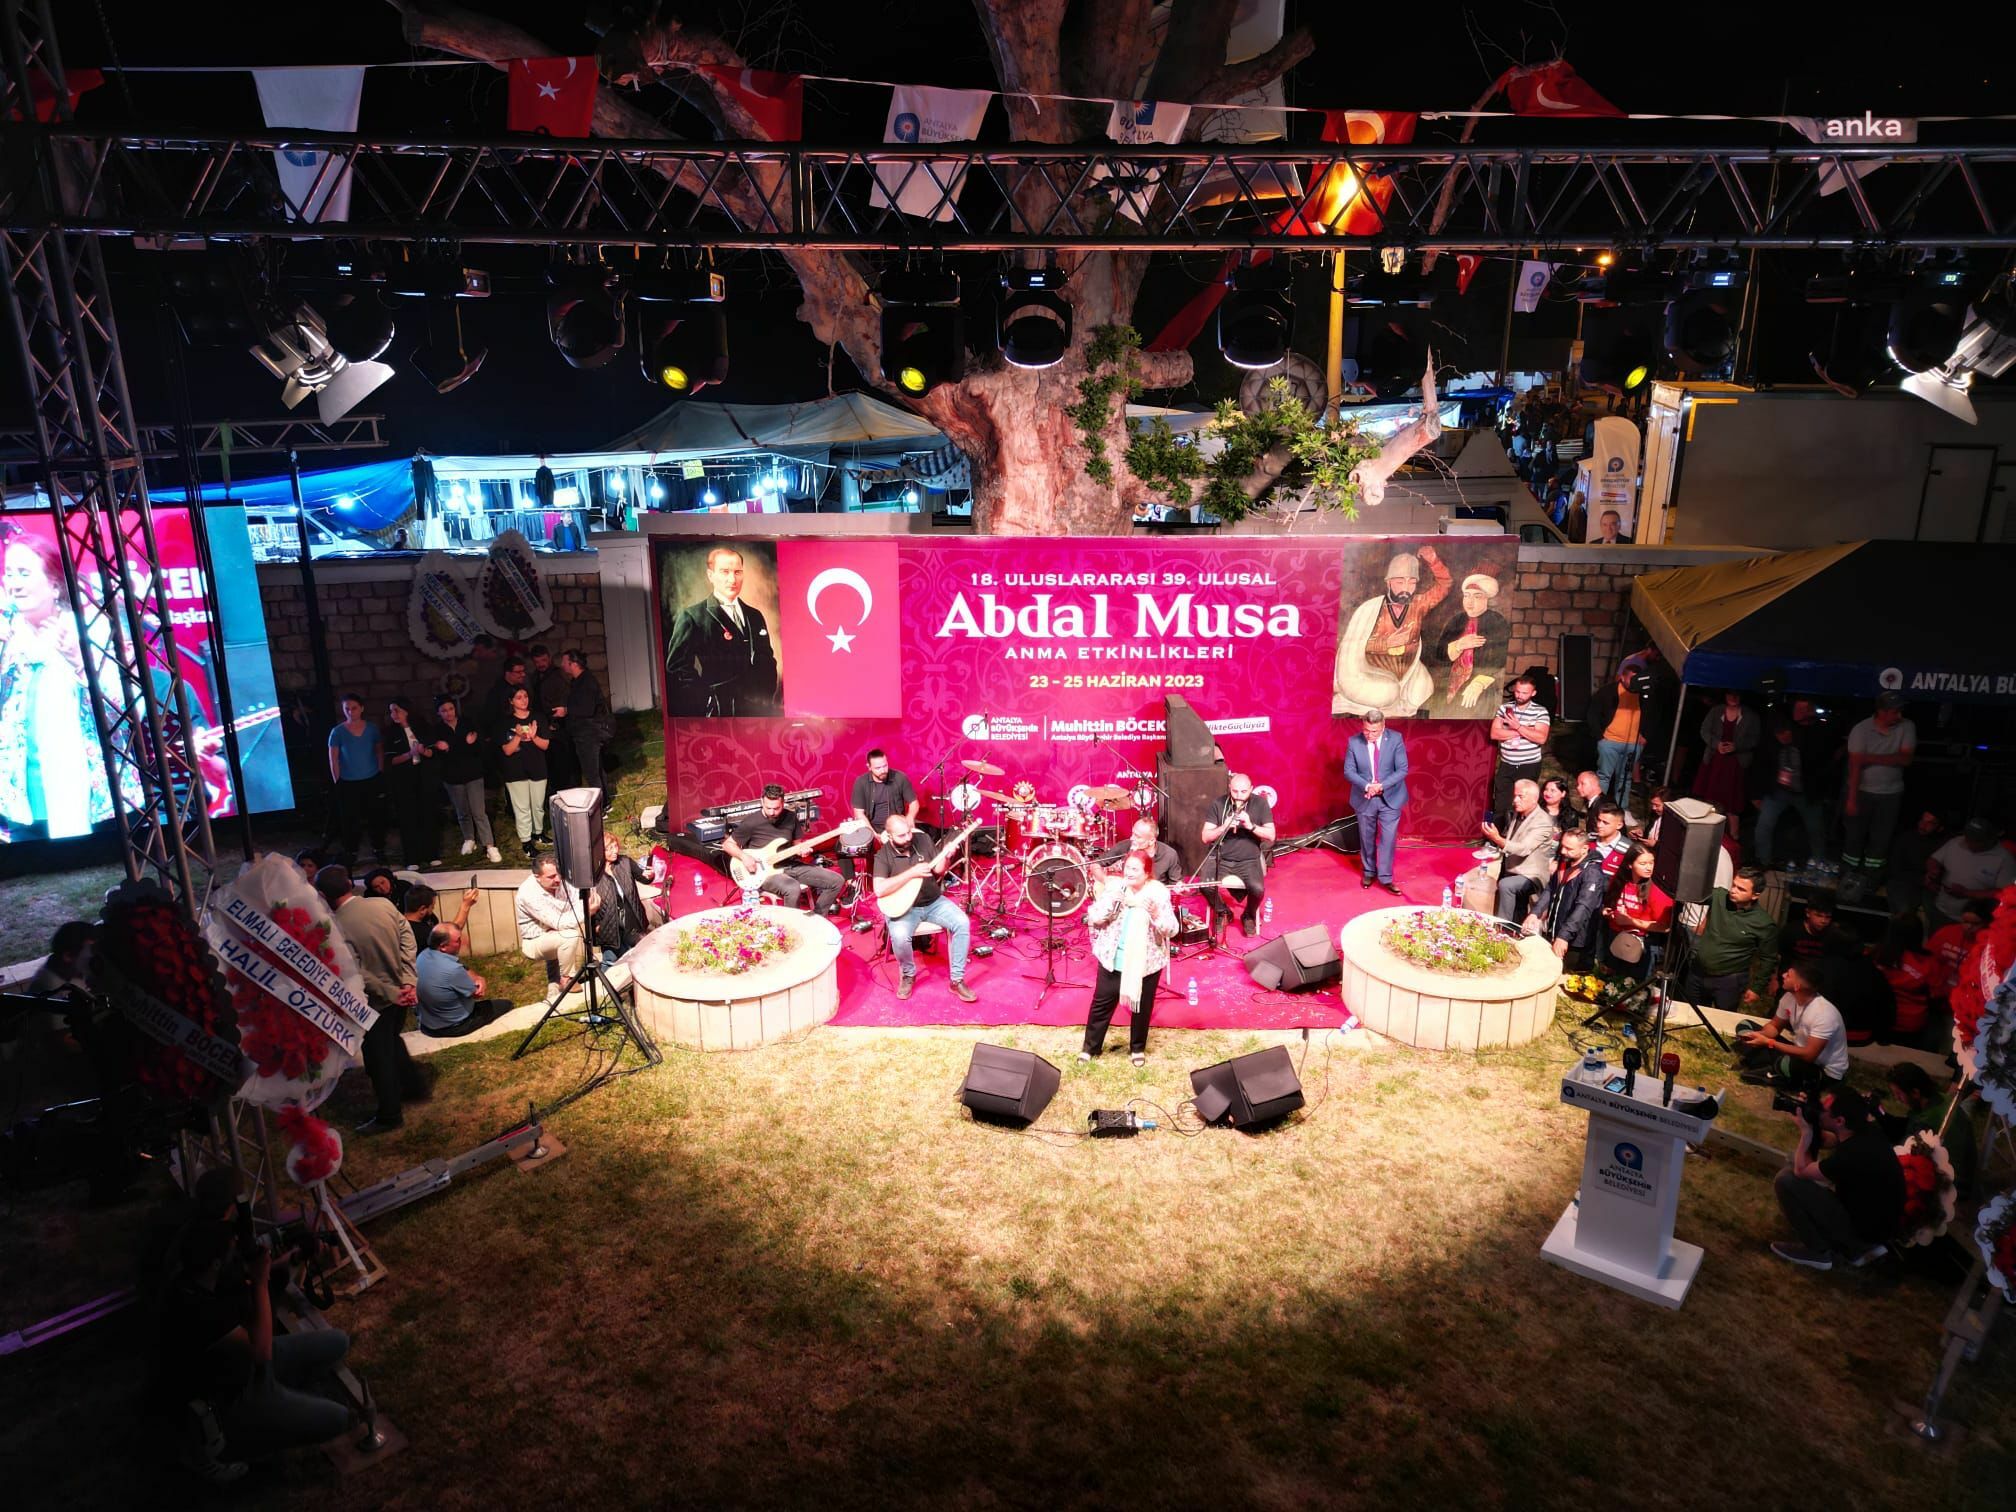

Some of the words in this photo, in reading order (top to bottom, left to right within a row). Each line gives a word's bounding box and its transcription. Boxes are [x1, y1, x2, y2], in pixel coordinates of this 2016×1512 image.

[971, 573, 998, 586] 18.
[1004, 573, 1155, 586] ULUSLARARASI
[1161, 573, 1191, 586] 39.
[1198, 572, 1276, 585] ULUSAL
[934, 591, 1112, 638] Abdal
[1133, 593, 1302, 638] Musa
[1004, 647, 1067, 660] ANMA
[1078, 644, 1233, 659] ETKİNLİKLERİ
[1029, 675, 1049, 688] 23
[1063, 675, 1083, 688] 25
[1087, 671, 1161, 688] HAZİRAN
[1165, 675, 1204, 687] 2023
[1910, 671, 1990, 693] ANTALYA
[990, 716, 1022, 724] ANTALYA
[1051, 719, 1113, 732] Muhittin
[1116, 717, 1166, 732] BÖCEK
[226, 899, 279, 942] ELMALI
[218, 938, 279, 992] HALİL
[287, 986, 355, 1047] ÖZTÜRK
[1576, 1092, 1607, 1105] ANTALYA
